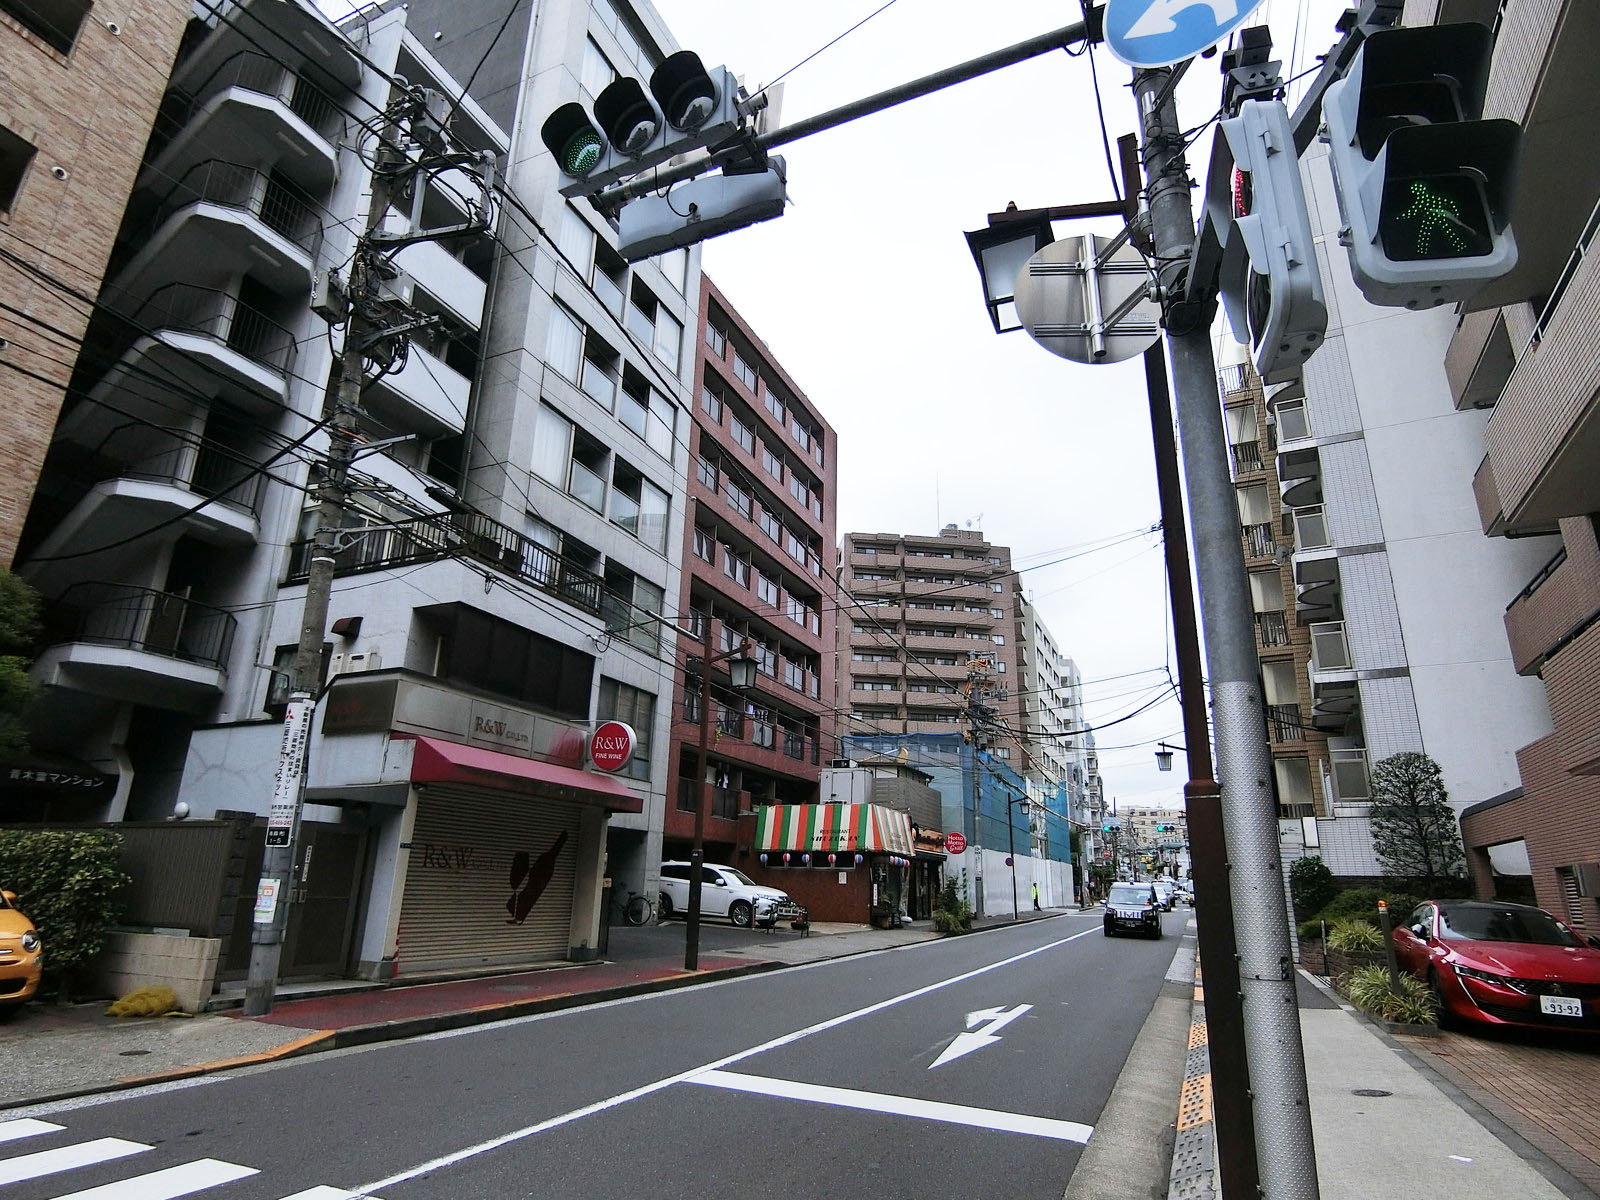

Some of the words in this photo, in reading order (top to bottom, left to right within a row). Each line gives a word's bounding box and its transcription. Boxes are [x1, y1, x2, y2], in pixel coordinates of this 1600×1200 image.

[475, 716, 507, 737] R&W
[595, 737, 628, 750] R&W
[1550, 1004, 1580, 1015] 93-92
